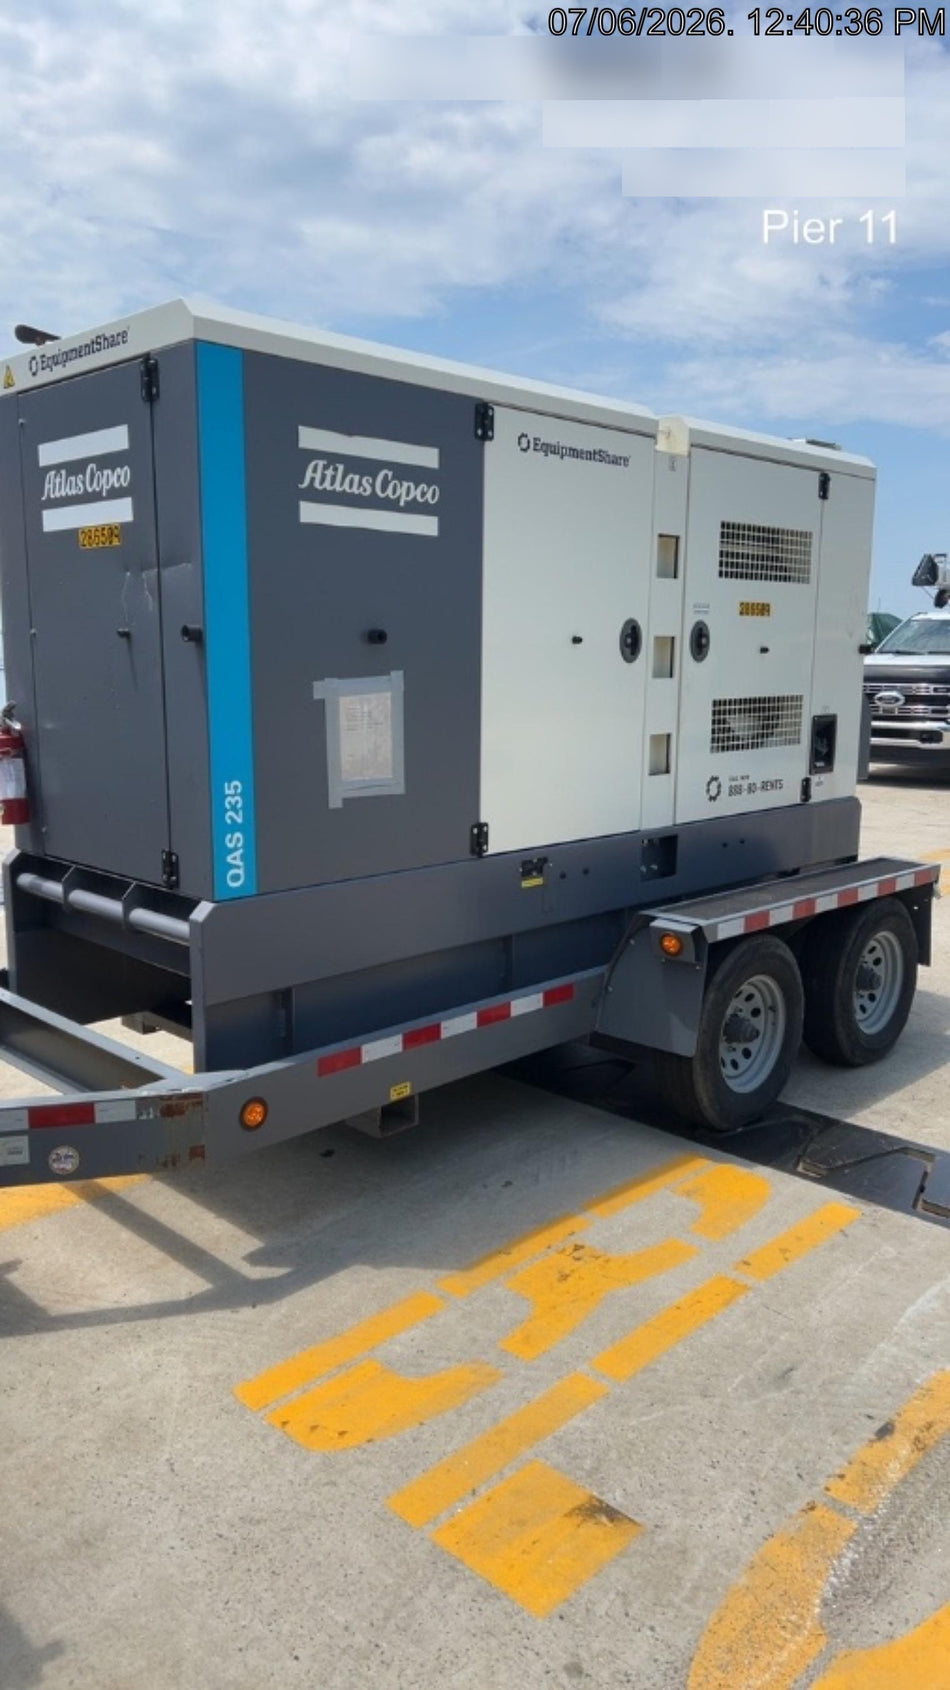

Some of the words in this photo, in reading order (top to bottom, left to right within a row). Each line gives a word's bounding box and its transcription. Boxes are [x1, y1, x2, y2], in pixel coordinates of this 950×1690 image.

[40, 329, 129, 372] EquipmentShare
[532, 436, 630, 468] EquipmentShare
[41, 468, 84, 501] Atlas
[85, 463, 131, 497] Copco
[298, 459, 373, 496] Atlas
[375, 469, 440, 507] Copco
[224, 780, 243, 824] 235
[225, 831, 245, 888] QAS
